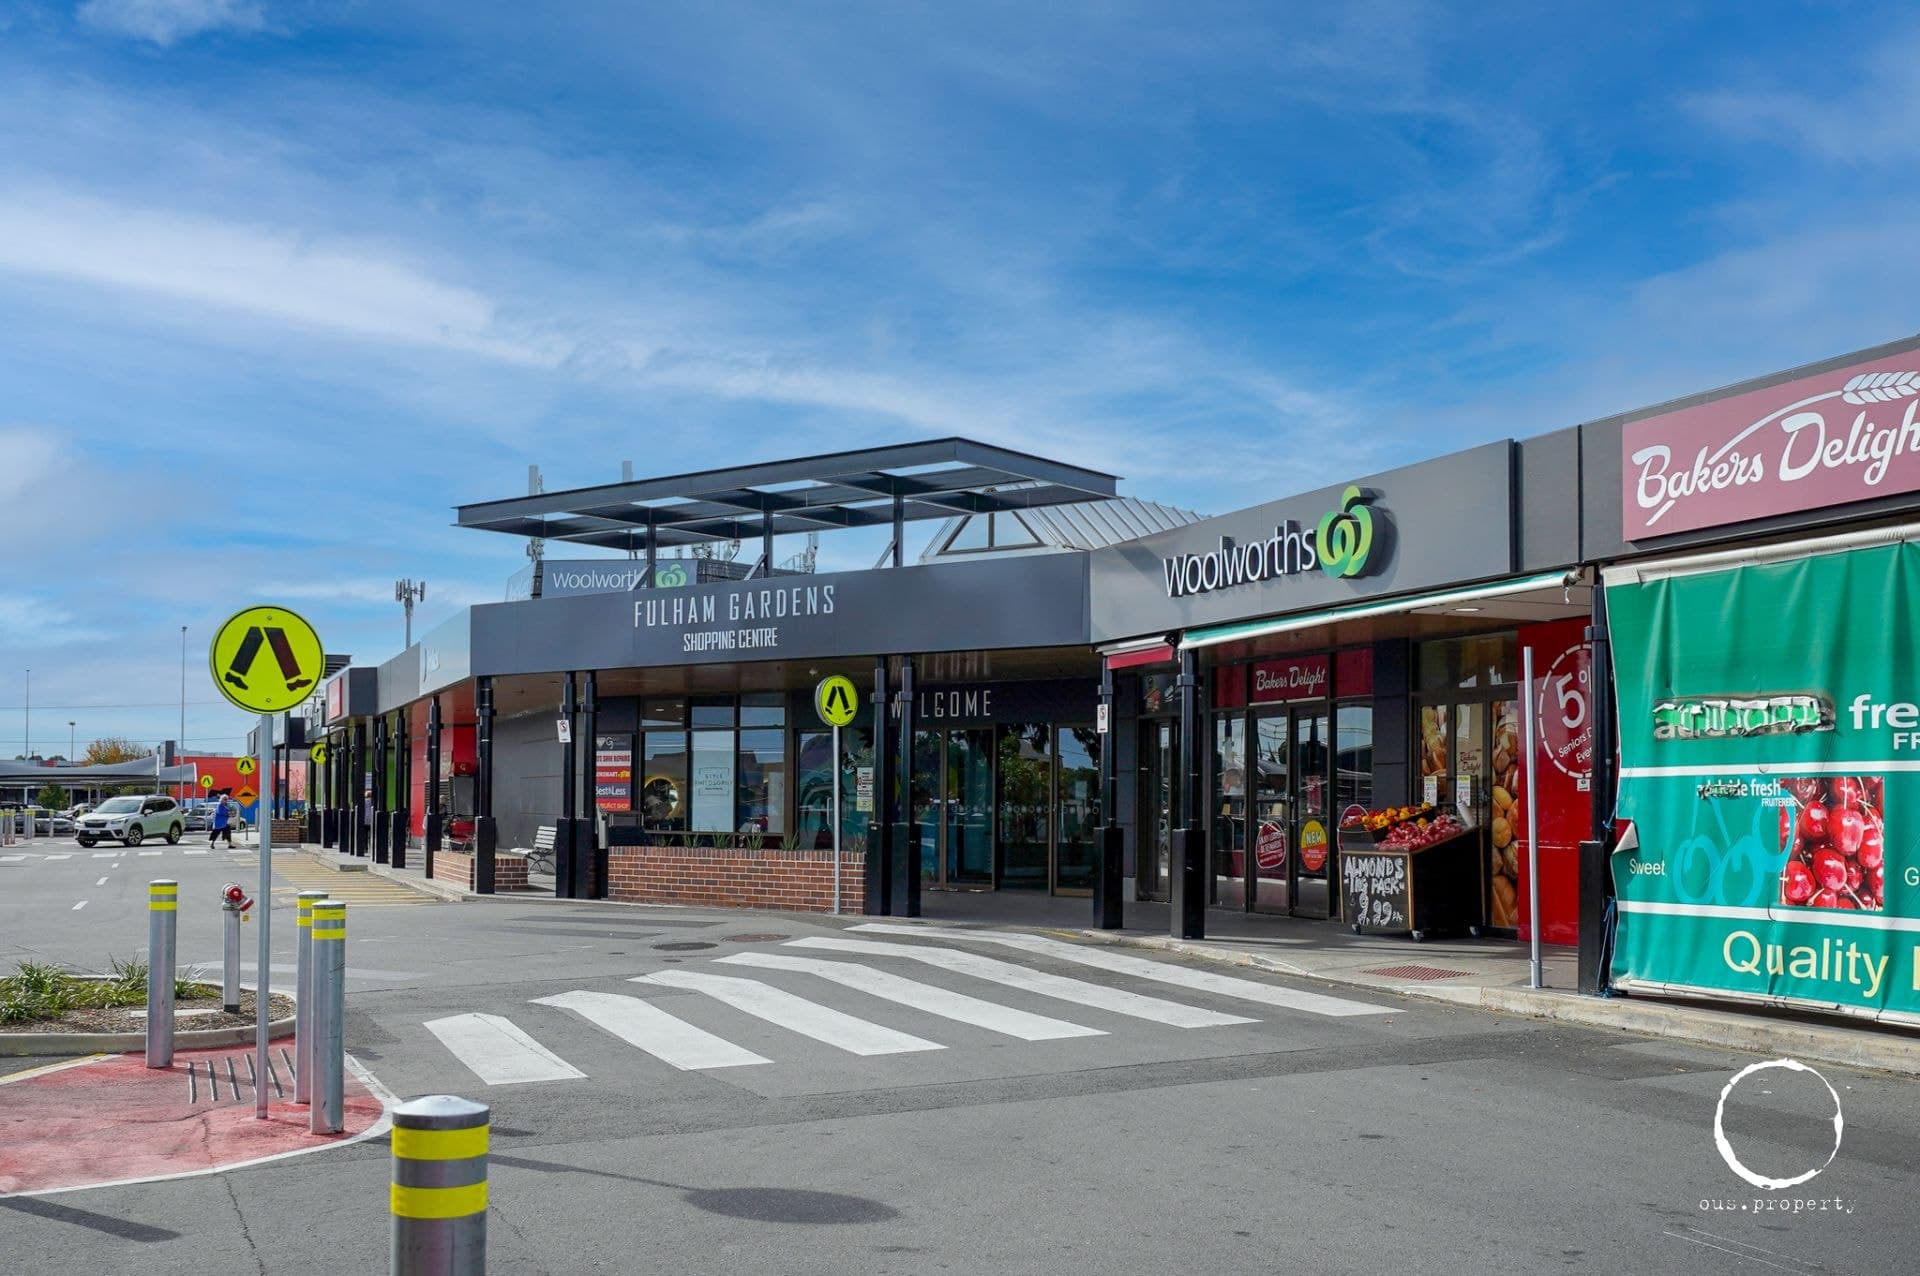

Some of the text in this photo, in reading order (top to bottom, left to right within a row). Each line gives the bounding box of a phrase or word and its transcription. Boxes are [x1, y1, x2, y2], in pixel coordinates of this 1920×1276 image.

[1632, 445, 1764, 509] Bakers
[1163, 519, 1317, 598] Woolworths
[552, 570, 647, 589] Woolworth
[634, 584, 835, 628] FULHAM GARDENS
[683, 627, 779, 652] SHOPPING CENTRE
[1255, 665, 1326, 695] Bakers Delight
[891, 689, 992, 719] WLCOME
[1558, 733, 1587, 757] Seniors
[1575, 747, 1592, 764] Eve
[1751, 777, 1781, 797] fresh
[1305, 831, 1322, 846] NEW
[1344, 856, 1404, 880] ALMONDS
[1629, 858, 1666, 877] Sweet
[1722, 930, 1890, 999] Quality
